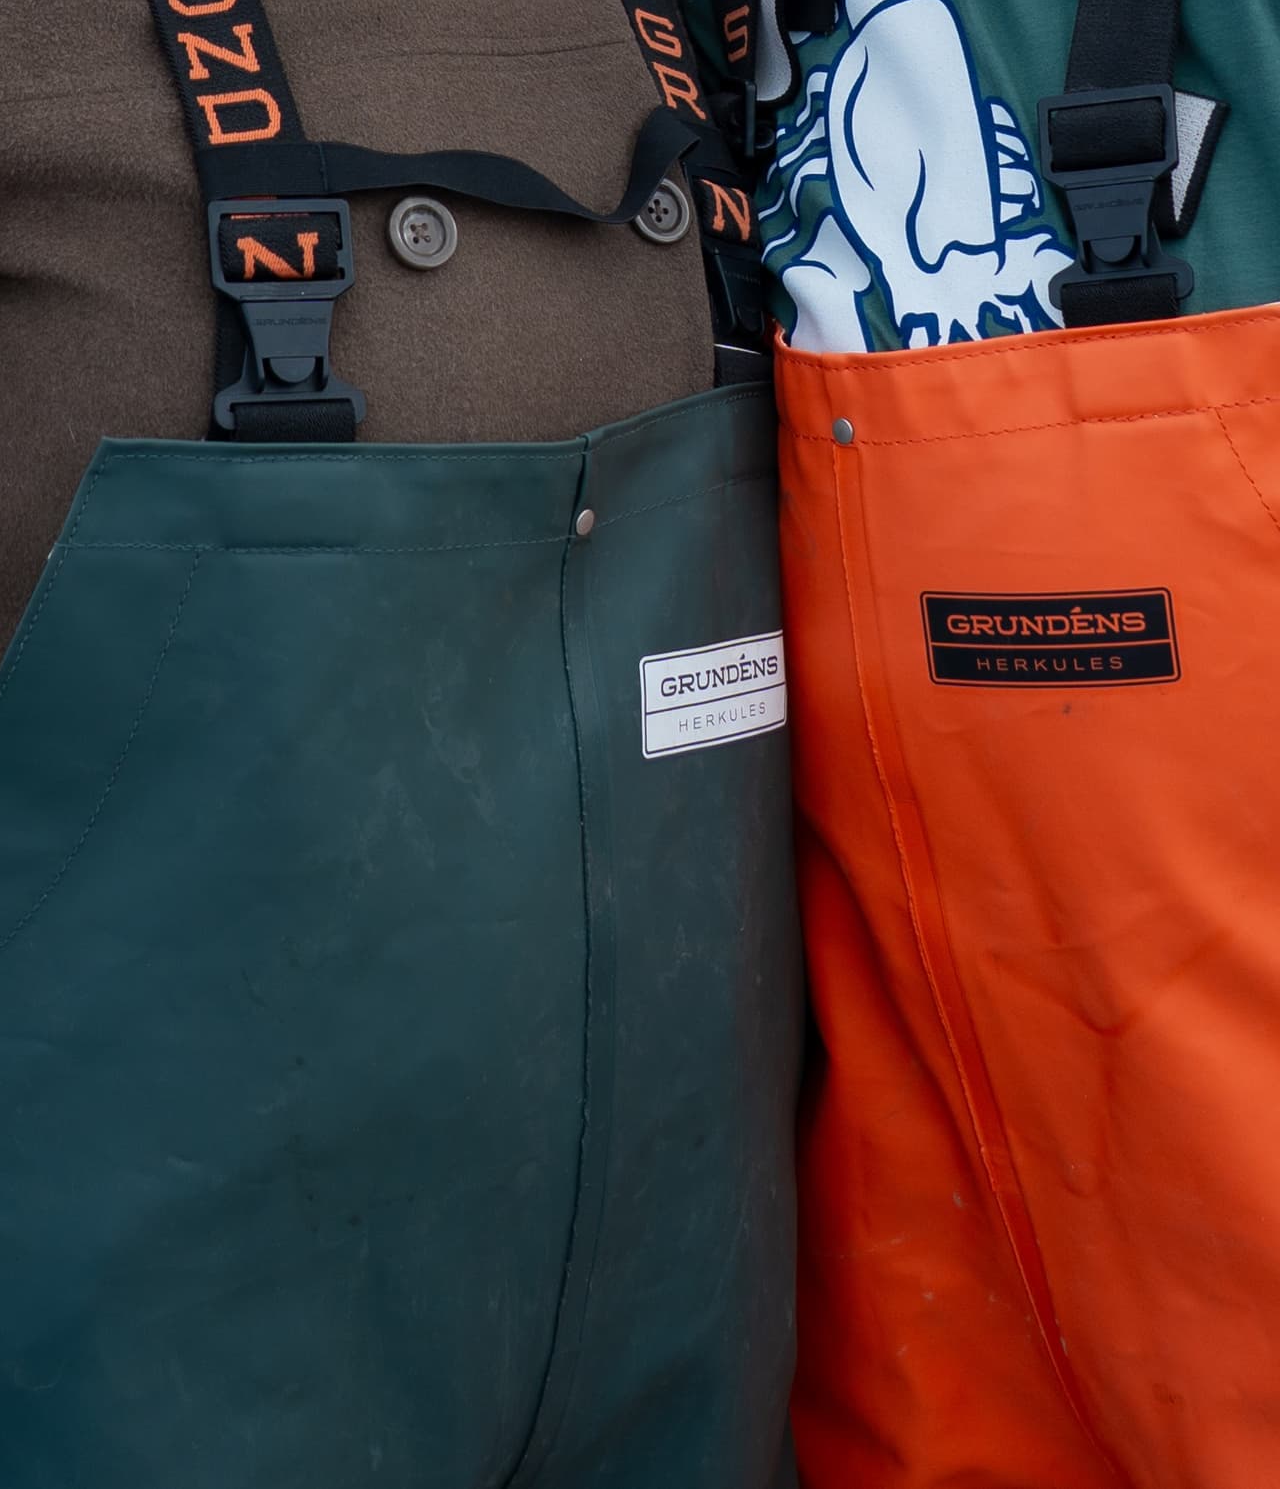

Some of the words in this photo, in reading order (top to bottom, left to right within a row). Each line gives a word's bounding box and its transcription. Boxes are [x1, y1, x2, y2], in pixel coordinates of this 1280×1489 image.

[946, 606, 1147, 636] GRUNDÉNS
[660, 653, 779, 698] GRUNDÉNS
[976, 656, 1124, 672] HERKULES
[678, 701, 767, 733] HERKULES
